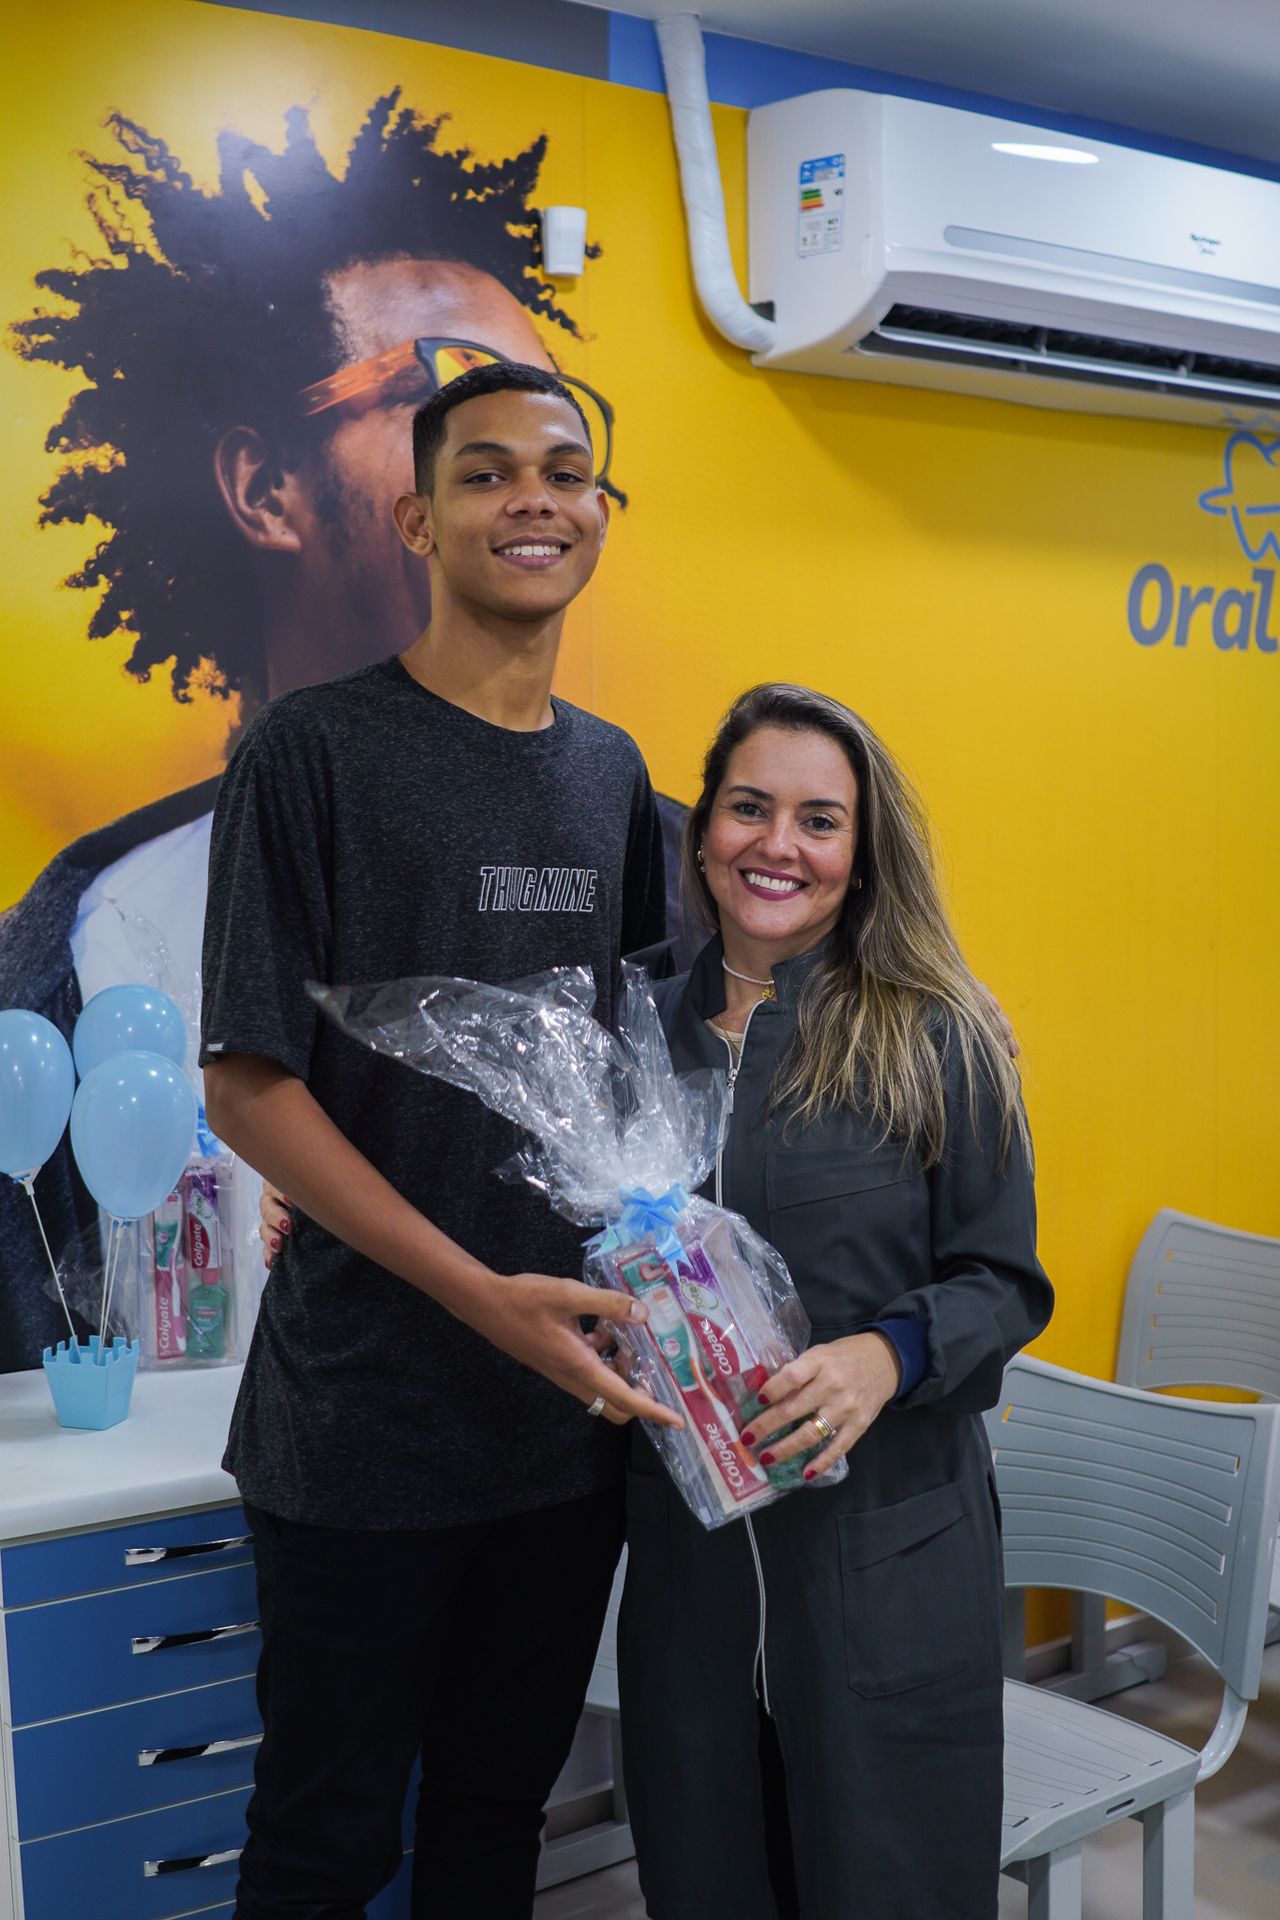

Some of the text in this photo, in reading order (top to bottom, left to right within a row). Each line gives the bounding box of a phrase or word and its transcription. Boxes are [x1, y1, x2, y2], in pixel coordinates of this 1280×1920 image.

[1127, 561, 1279, 653] Oral
[478, 866, 598, 912] THUGNINE
[194, 1223, 203, 1267] Colgate
[159, 1296, 171, 1350] Colgate
[700, 1319, 733, 1375] Colgate
[706, 1422, 744, 1488] Colgate
